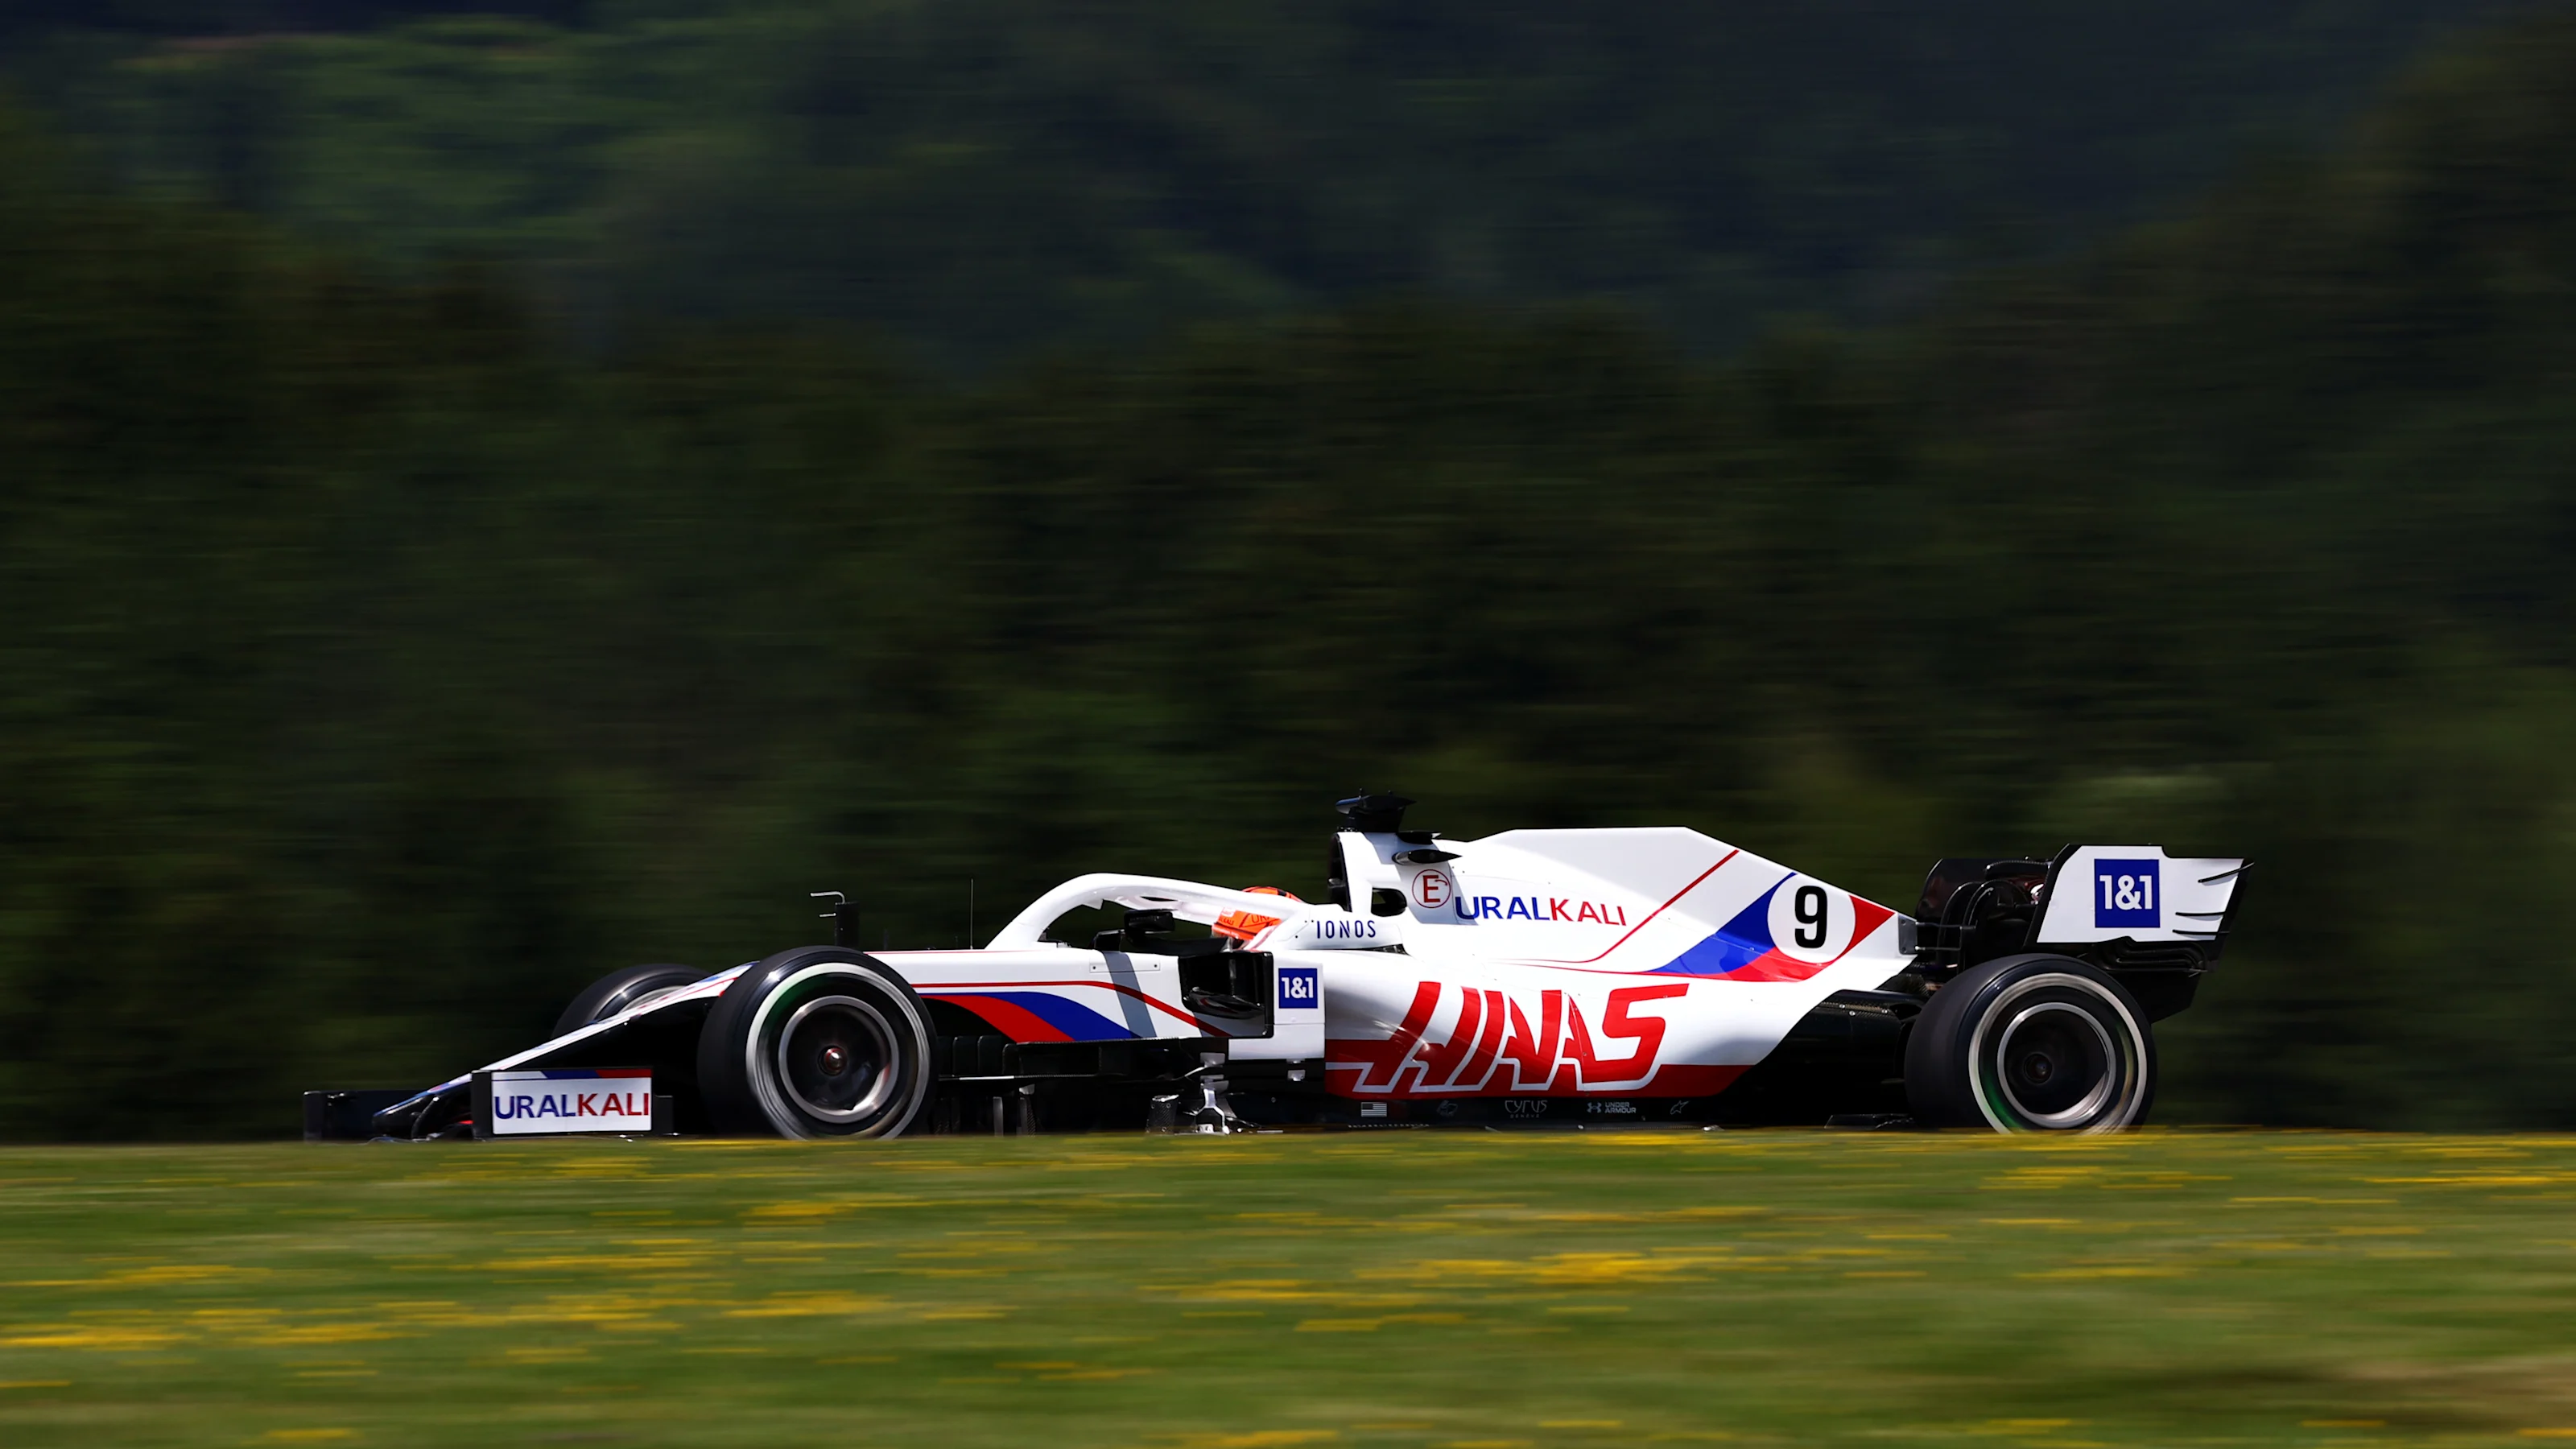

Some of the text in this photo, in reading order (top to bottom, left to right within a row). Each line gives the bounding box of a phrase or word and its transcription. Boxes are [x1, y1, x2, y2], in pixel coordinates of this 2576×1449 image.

[2099, 875, 2153, 910] 1&1
[1455, 896, 1627, 926] URALKALI
[1794, 886, 1828, 948] 9
[1316, 919, 1376, 939] IONOS
[1282, 976, 1314, 998] 1&1
[1356, 980, 1690, 1093] HAAS
[494, 1092, 649, 1119] URALKALI
